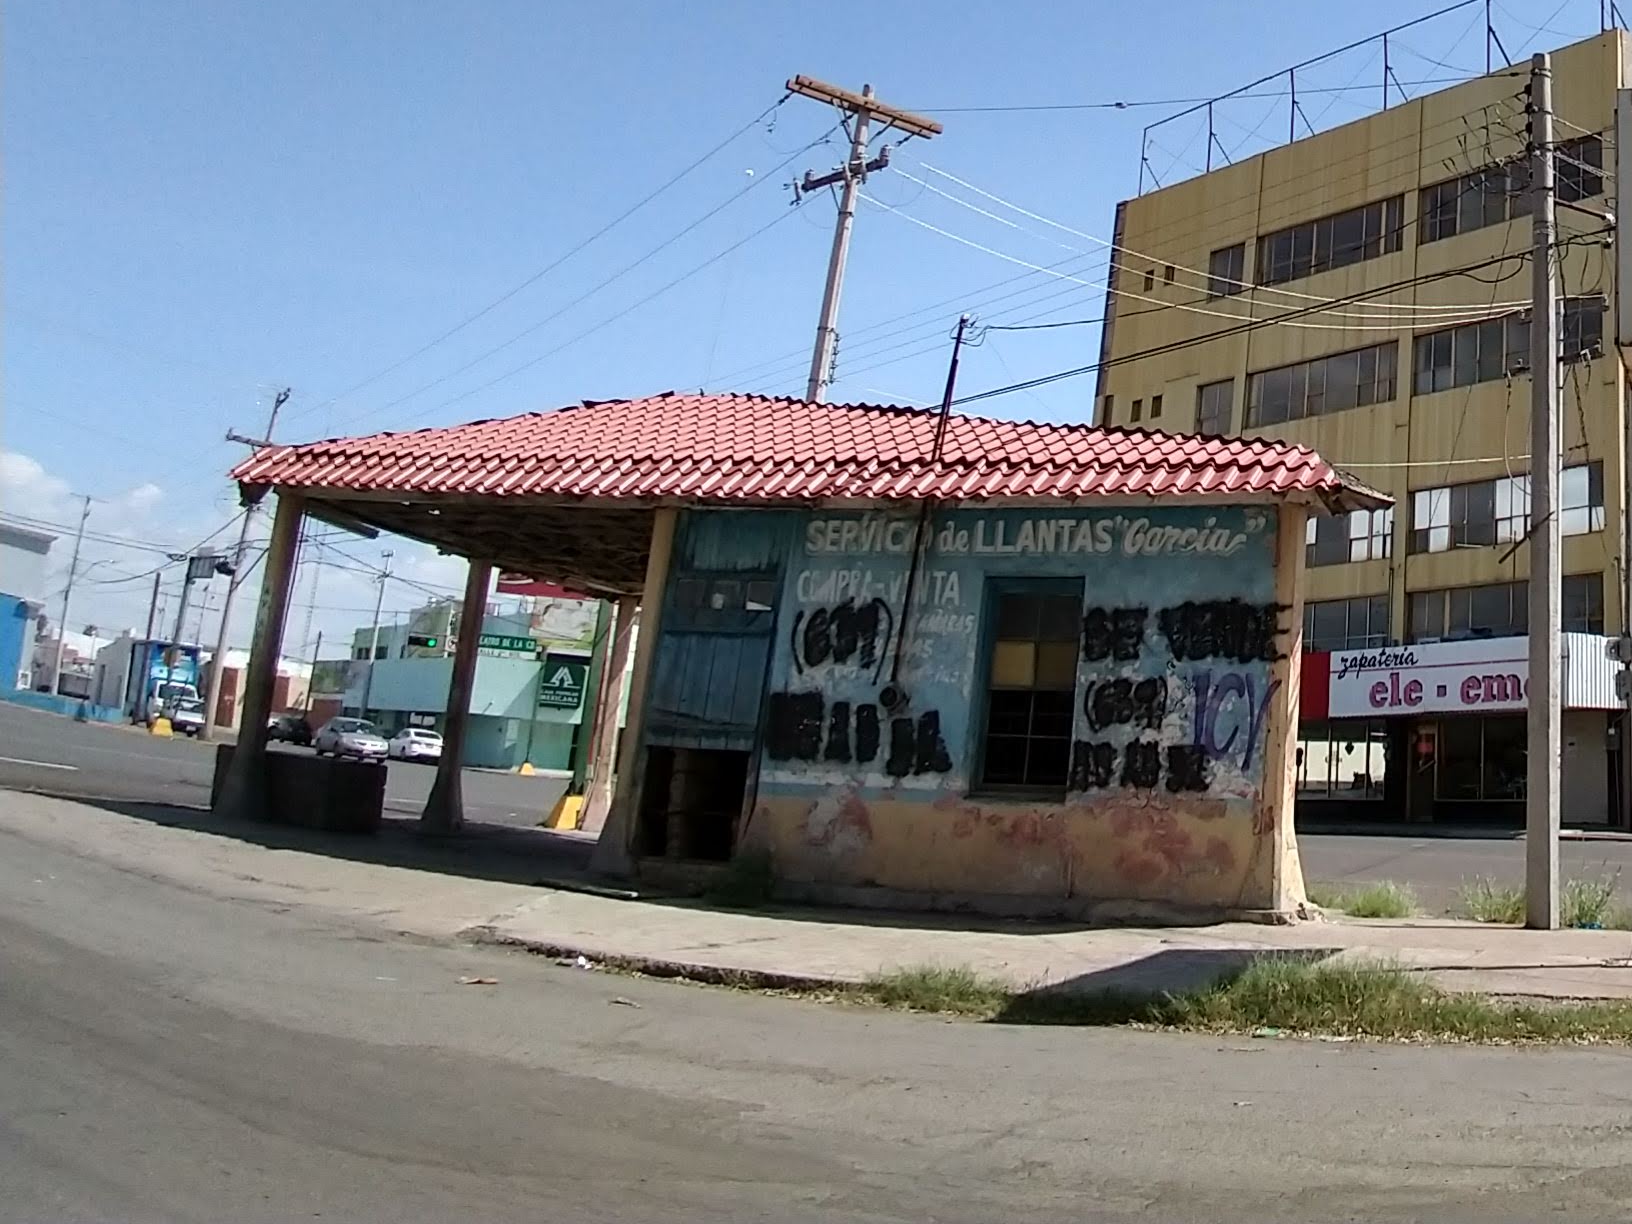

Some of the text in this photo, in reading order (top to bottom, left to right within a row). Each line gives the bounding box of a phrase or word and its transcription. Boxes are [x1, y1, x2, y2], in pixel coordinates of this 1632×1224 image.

[939, 520, 970, 554] de
[975, 518, 1114, 555] LLANTAS
[1369, 672, 1423, 708] ele
